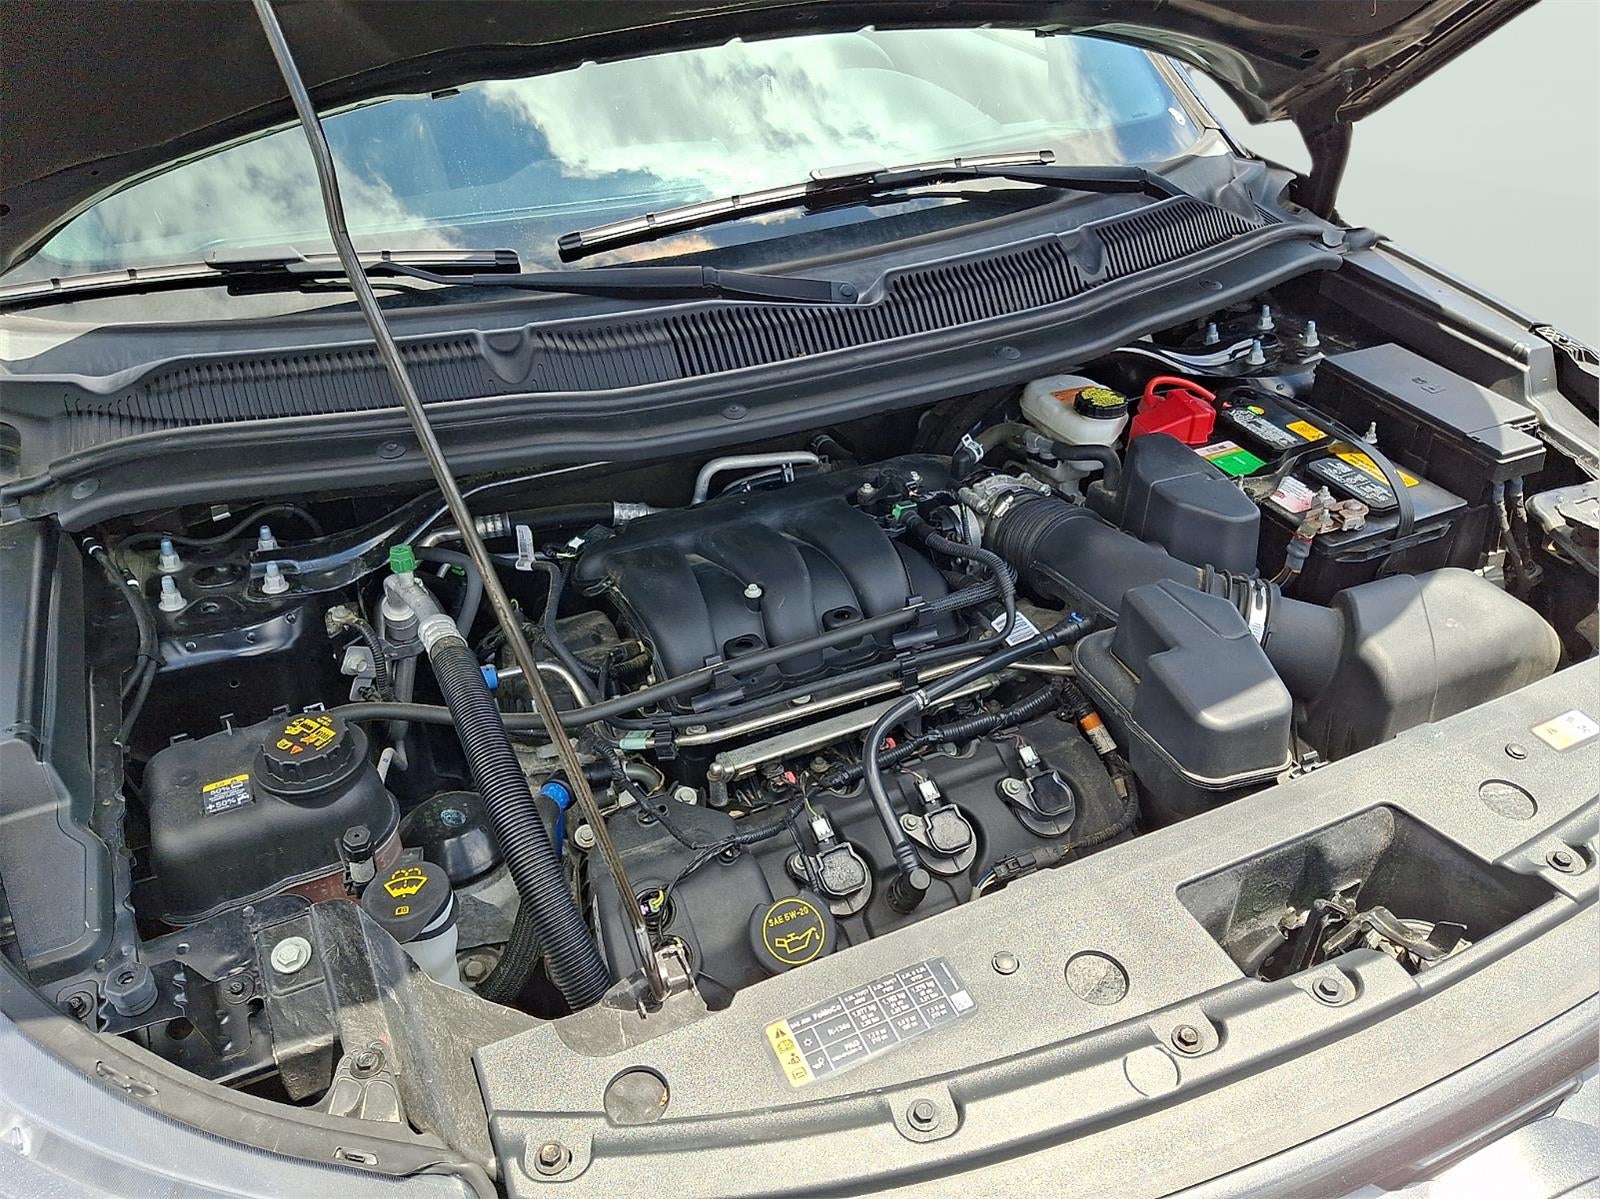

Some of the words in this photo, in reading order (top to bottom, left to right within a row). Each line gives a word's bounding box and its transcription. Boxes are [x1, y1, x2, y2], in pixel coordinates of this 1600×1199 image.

[768, 915, 784, 927] SAE
[784, 906, 809, 921] 5W-20
[812, 1004, 842, 1021] FoMoCo
